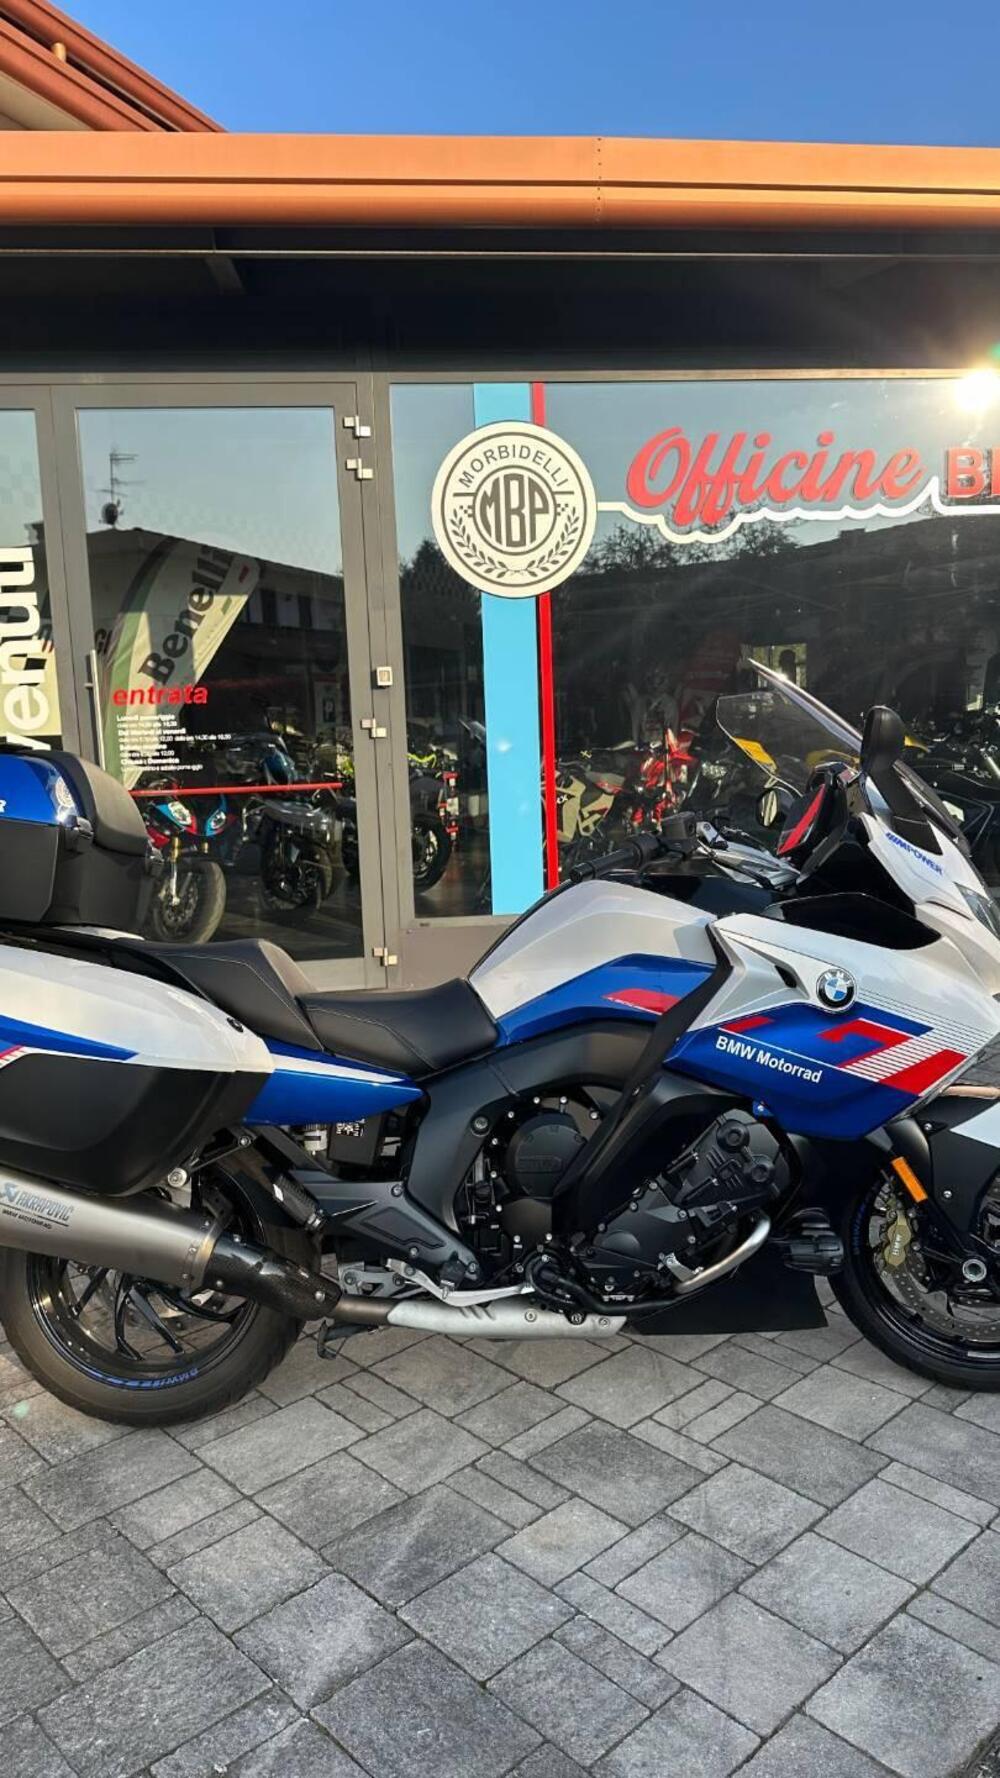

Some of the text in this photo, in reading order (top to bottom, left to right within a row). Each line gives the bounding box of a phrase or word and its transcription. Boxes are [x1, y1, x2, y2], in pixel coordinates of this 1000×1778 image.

[458, 444, 569, 489] MORBIDELLI
[625, 426, 926, 526] Officine
[479, 473, 550, 548] MBP
[112, 684, 209, 706] entrata
[715, 1035, 823, 1084] BMW Motorrad
